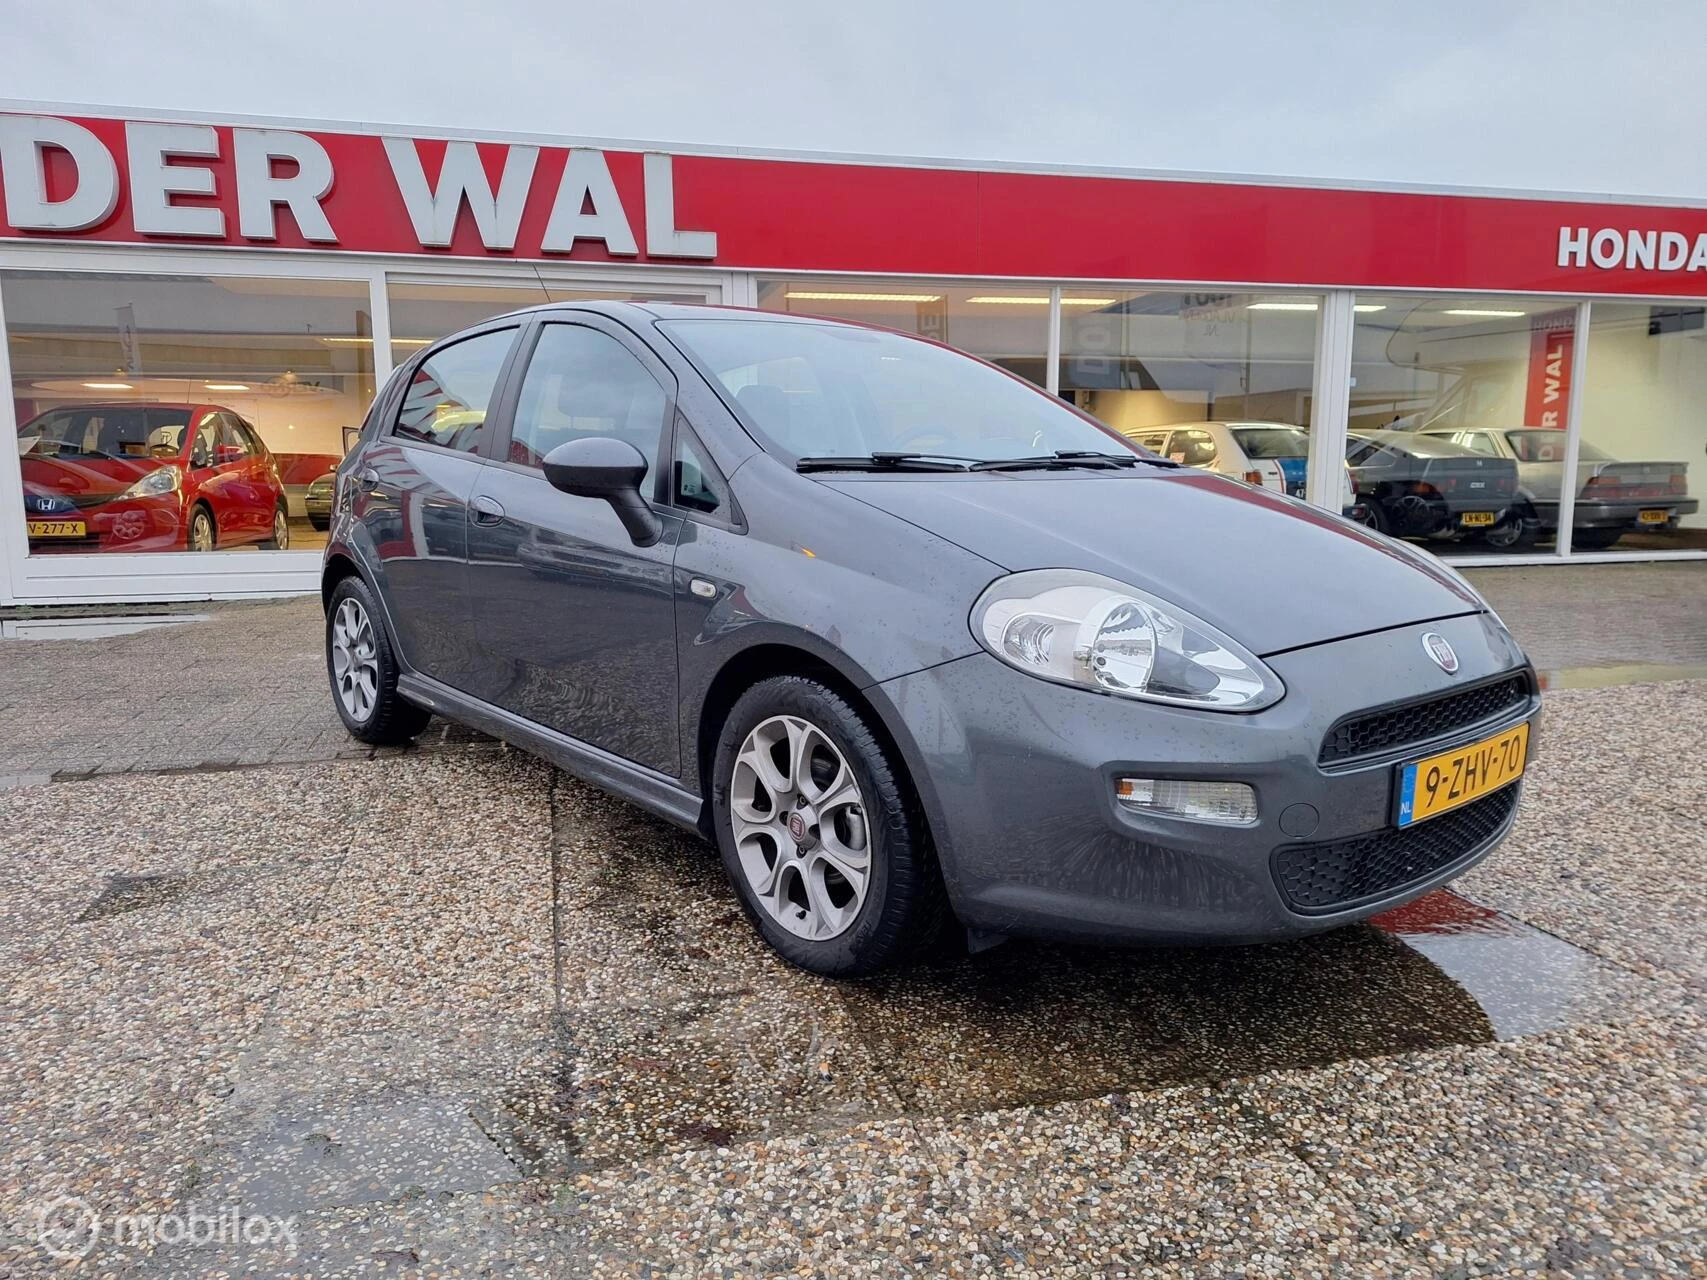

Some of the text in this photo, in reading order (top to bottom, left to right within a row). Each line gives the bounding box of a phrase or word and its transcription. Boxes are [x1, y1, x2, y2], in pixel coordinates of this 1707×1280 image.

[0, 115, 717, 258] DER WAL
[1557, 226, 1707, 271] HONDA
[1543, 344, 1563, 404] WAL
[28, 523, 78, 534] V-277-X
[1426, 735, 1520, 808] 9-ZHV-70
[1401, 802, 1411, 812] NL
